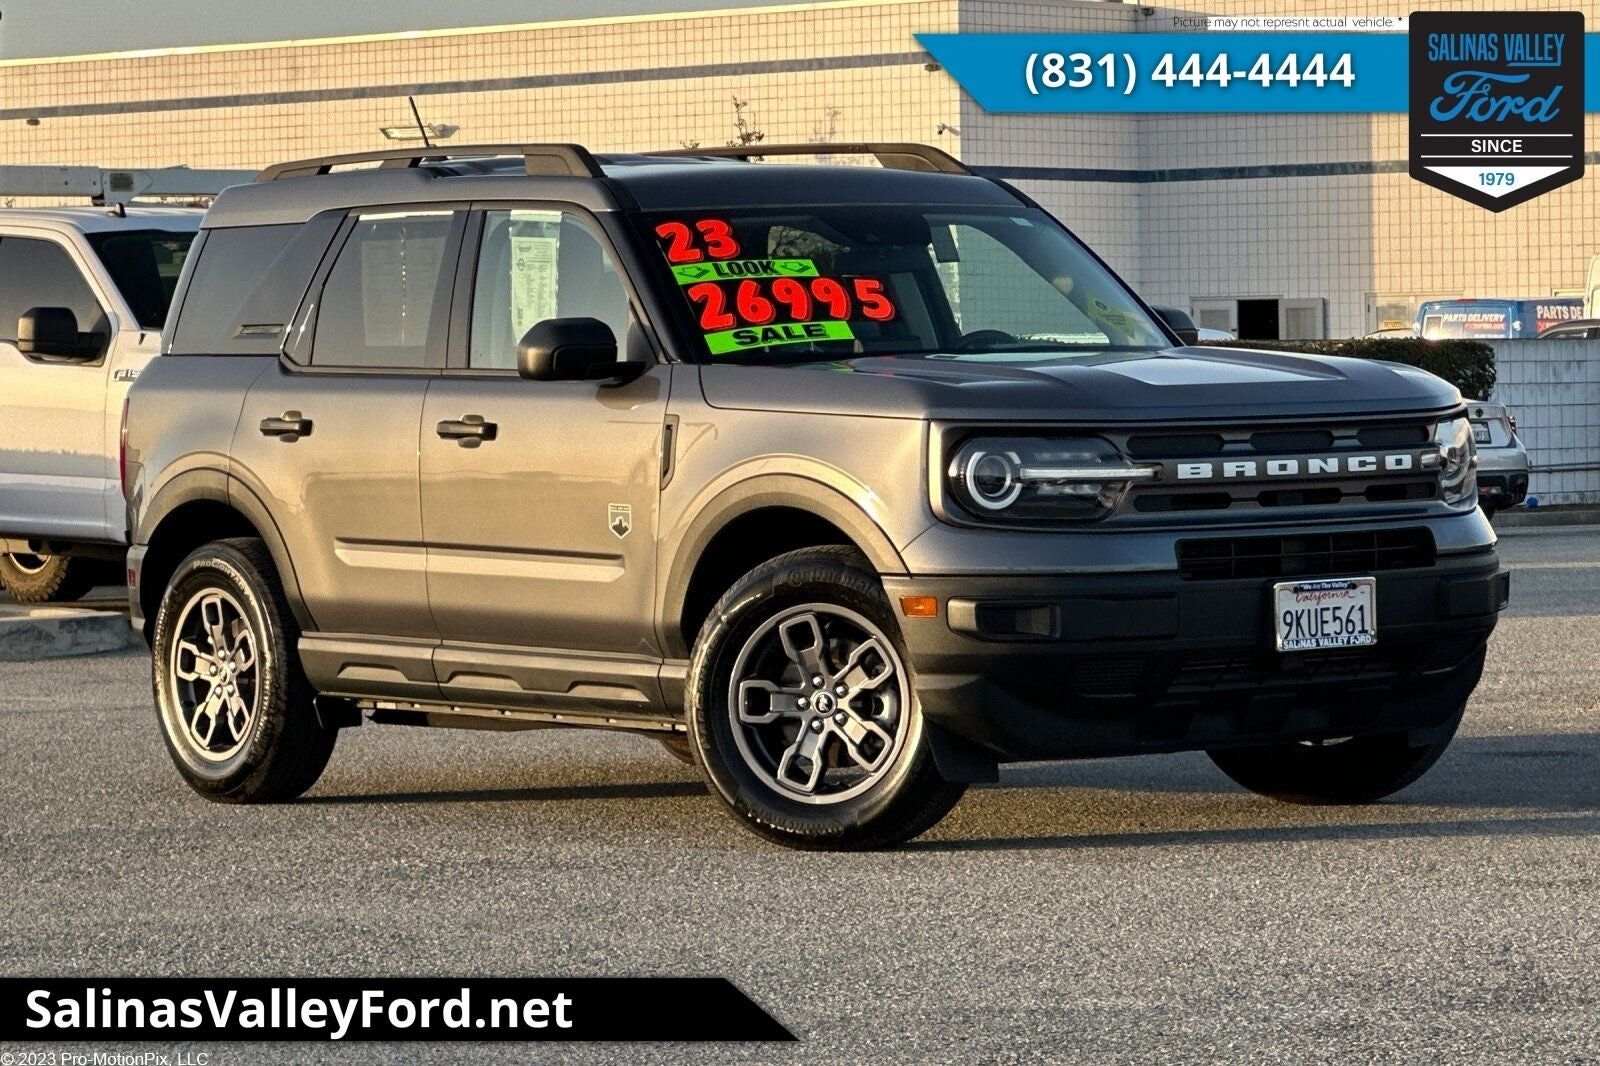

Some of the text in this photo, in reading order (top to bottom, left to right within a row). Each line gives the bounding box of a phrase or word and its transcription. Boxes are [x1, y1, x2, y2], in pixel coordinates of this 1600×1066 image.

[655, 219, 741, 263] 23
[711, 260, 780, 278] LOOK
[687, 277, 896, 331] 26995
[1536, 305, 1583, 320] PARTS DE
[1443, 313, 1506, 322] PARTS DELIVERY
[732, 323, 830, 347] SALE
[1177, 454, 1412, 479] BRONCO
[1295, 591, 1355, 605] California
[1283, 604, 1368, 640] 9KUE561
[1283, 635, 1372, 650] SALINAS VALLEY FORD
